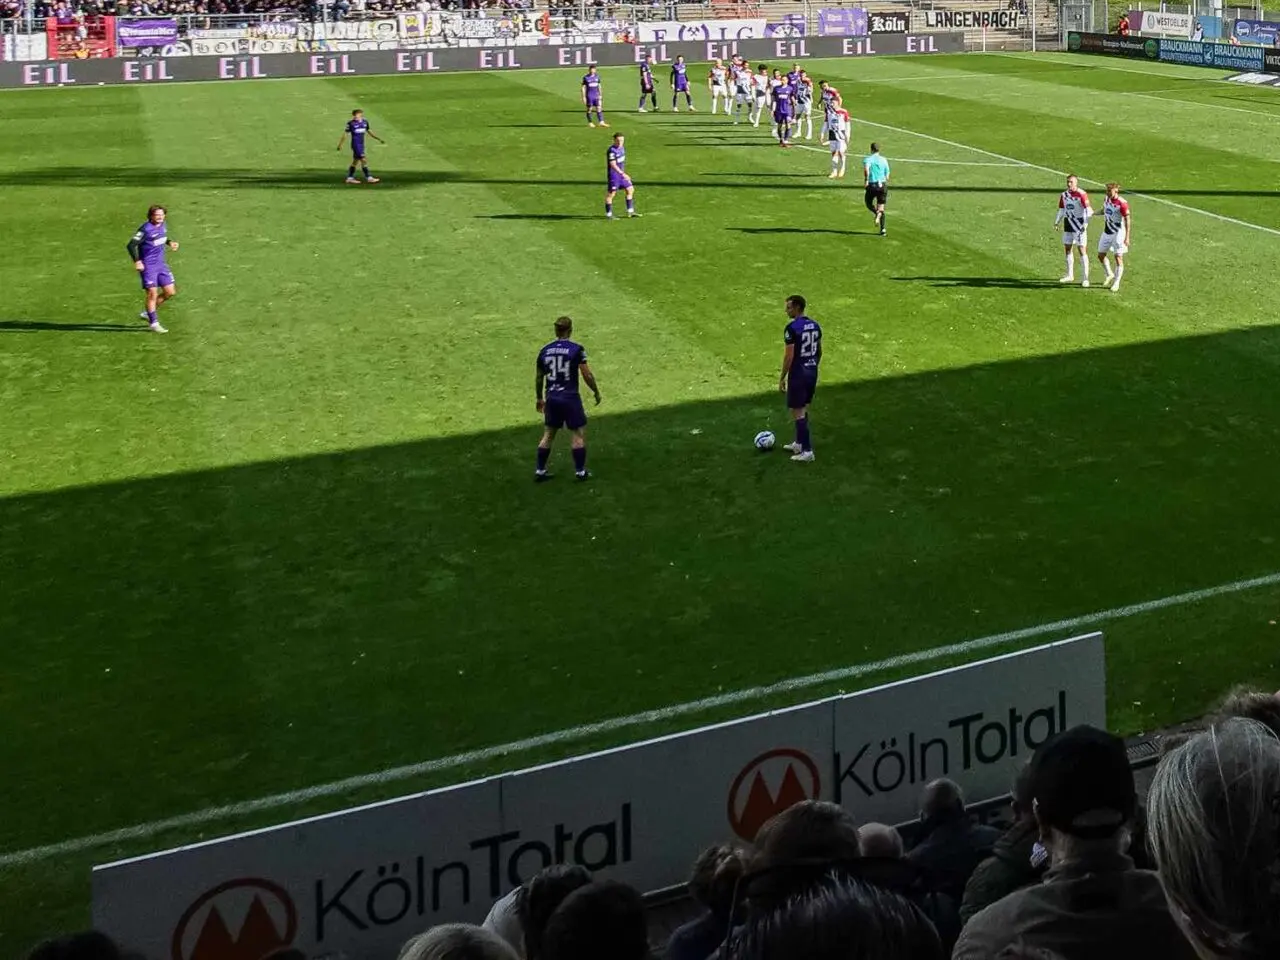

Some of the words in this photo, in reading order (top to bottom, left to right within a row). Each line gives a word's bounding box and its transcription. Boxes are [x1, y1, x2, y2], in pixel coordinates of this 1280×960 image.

[871, 16, 906, 31] Köln
[925, 11, 1018, 28] LANGENBACH
[1160, 40, 1203, 54] BRAUCKMANN
[1214, 46, 1262, 59] BRAUCKMANN
[544, 355, 570, 380] 34
